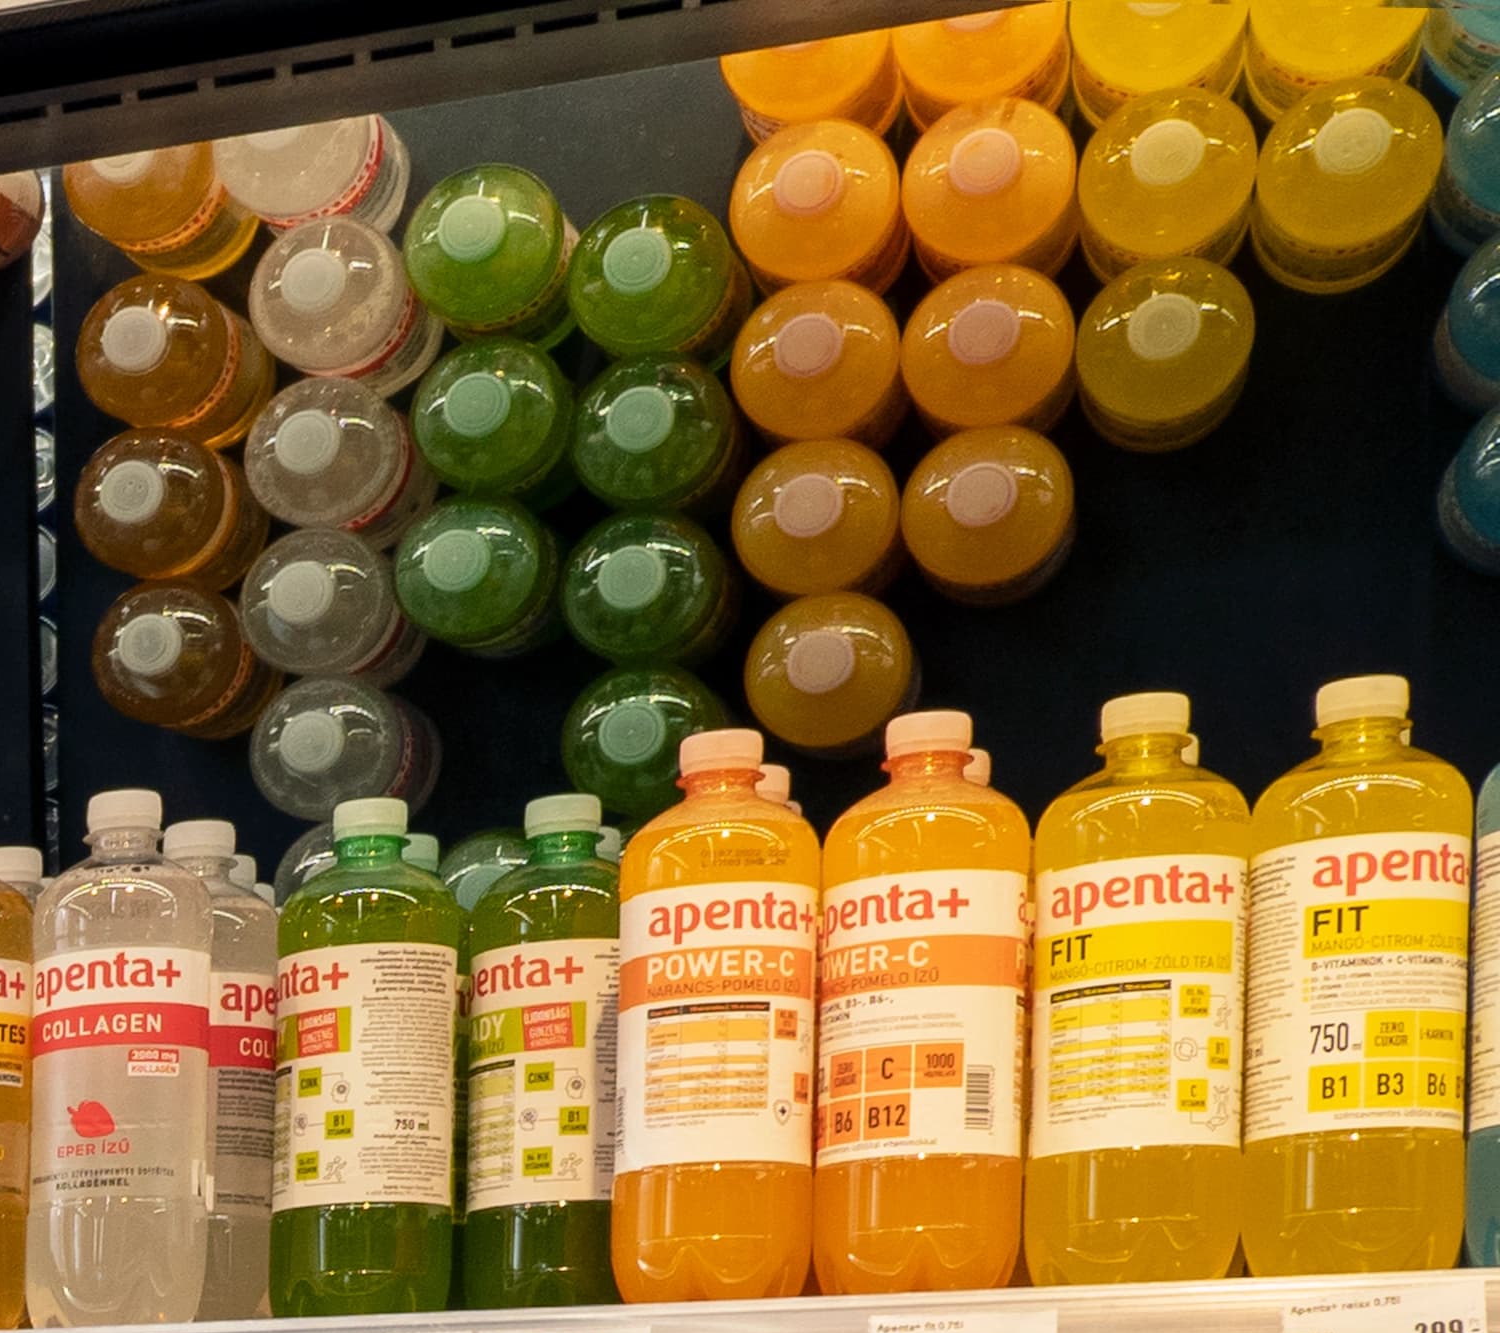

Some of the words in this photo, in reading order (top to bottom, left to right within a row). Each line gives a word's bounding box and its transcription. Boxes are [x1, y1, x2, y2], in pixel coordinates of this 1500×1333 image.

[1051, 863, 1236, 925] apenta+
[649, 892, 814, 945] apenta+
[1312, 906, 1370, 937] FIT
[647, 949, 795, 981] POWER-C
[1050, 934, 1092, 967] FIT
[35, 952, 182, 1007] apenta+
[42, 1014, 162, 1043] COLLAGEN
[1311, 1023, 1350, 1055] 750
[880, 1058, 893, 1080] C
[925, 1053, 955, 1069] 1000
[1321, 1075, 1348, 1100] B1
[1376, 1073, 1404, 1097] B3
[1427, 1073, 1447, 1096] B6
[834, 1110, 853, 1134] B6
[868, 1105, 907, 1129] B12
[57, 1144, 98, 1160] EPER
